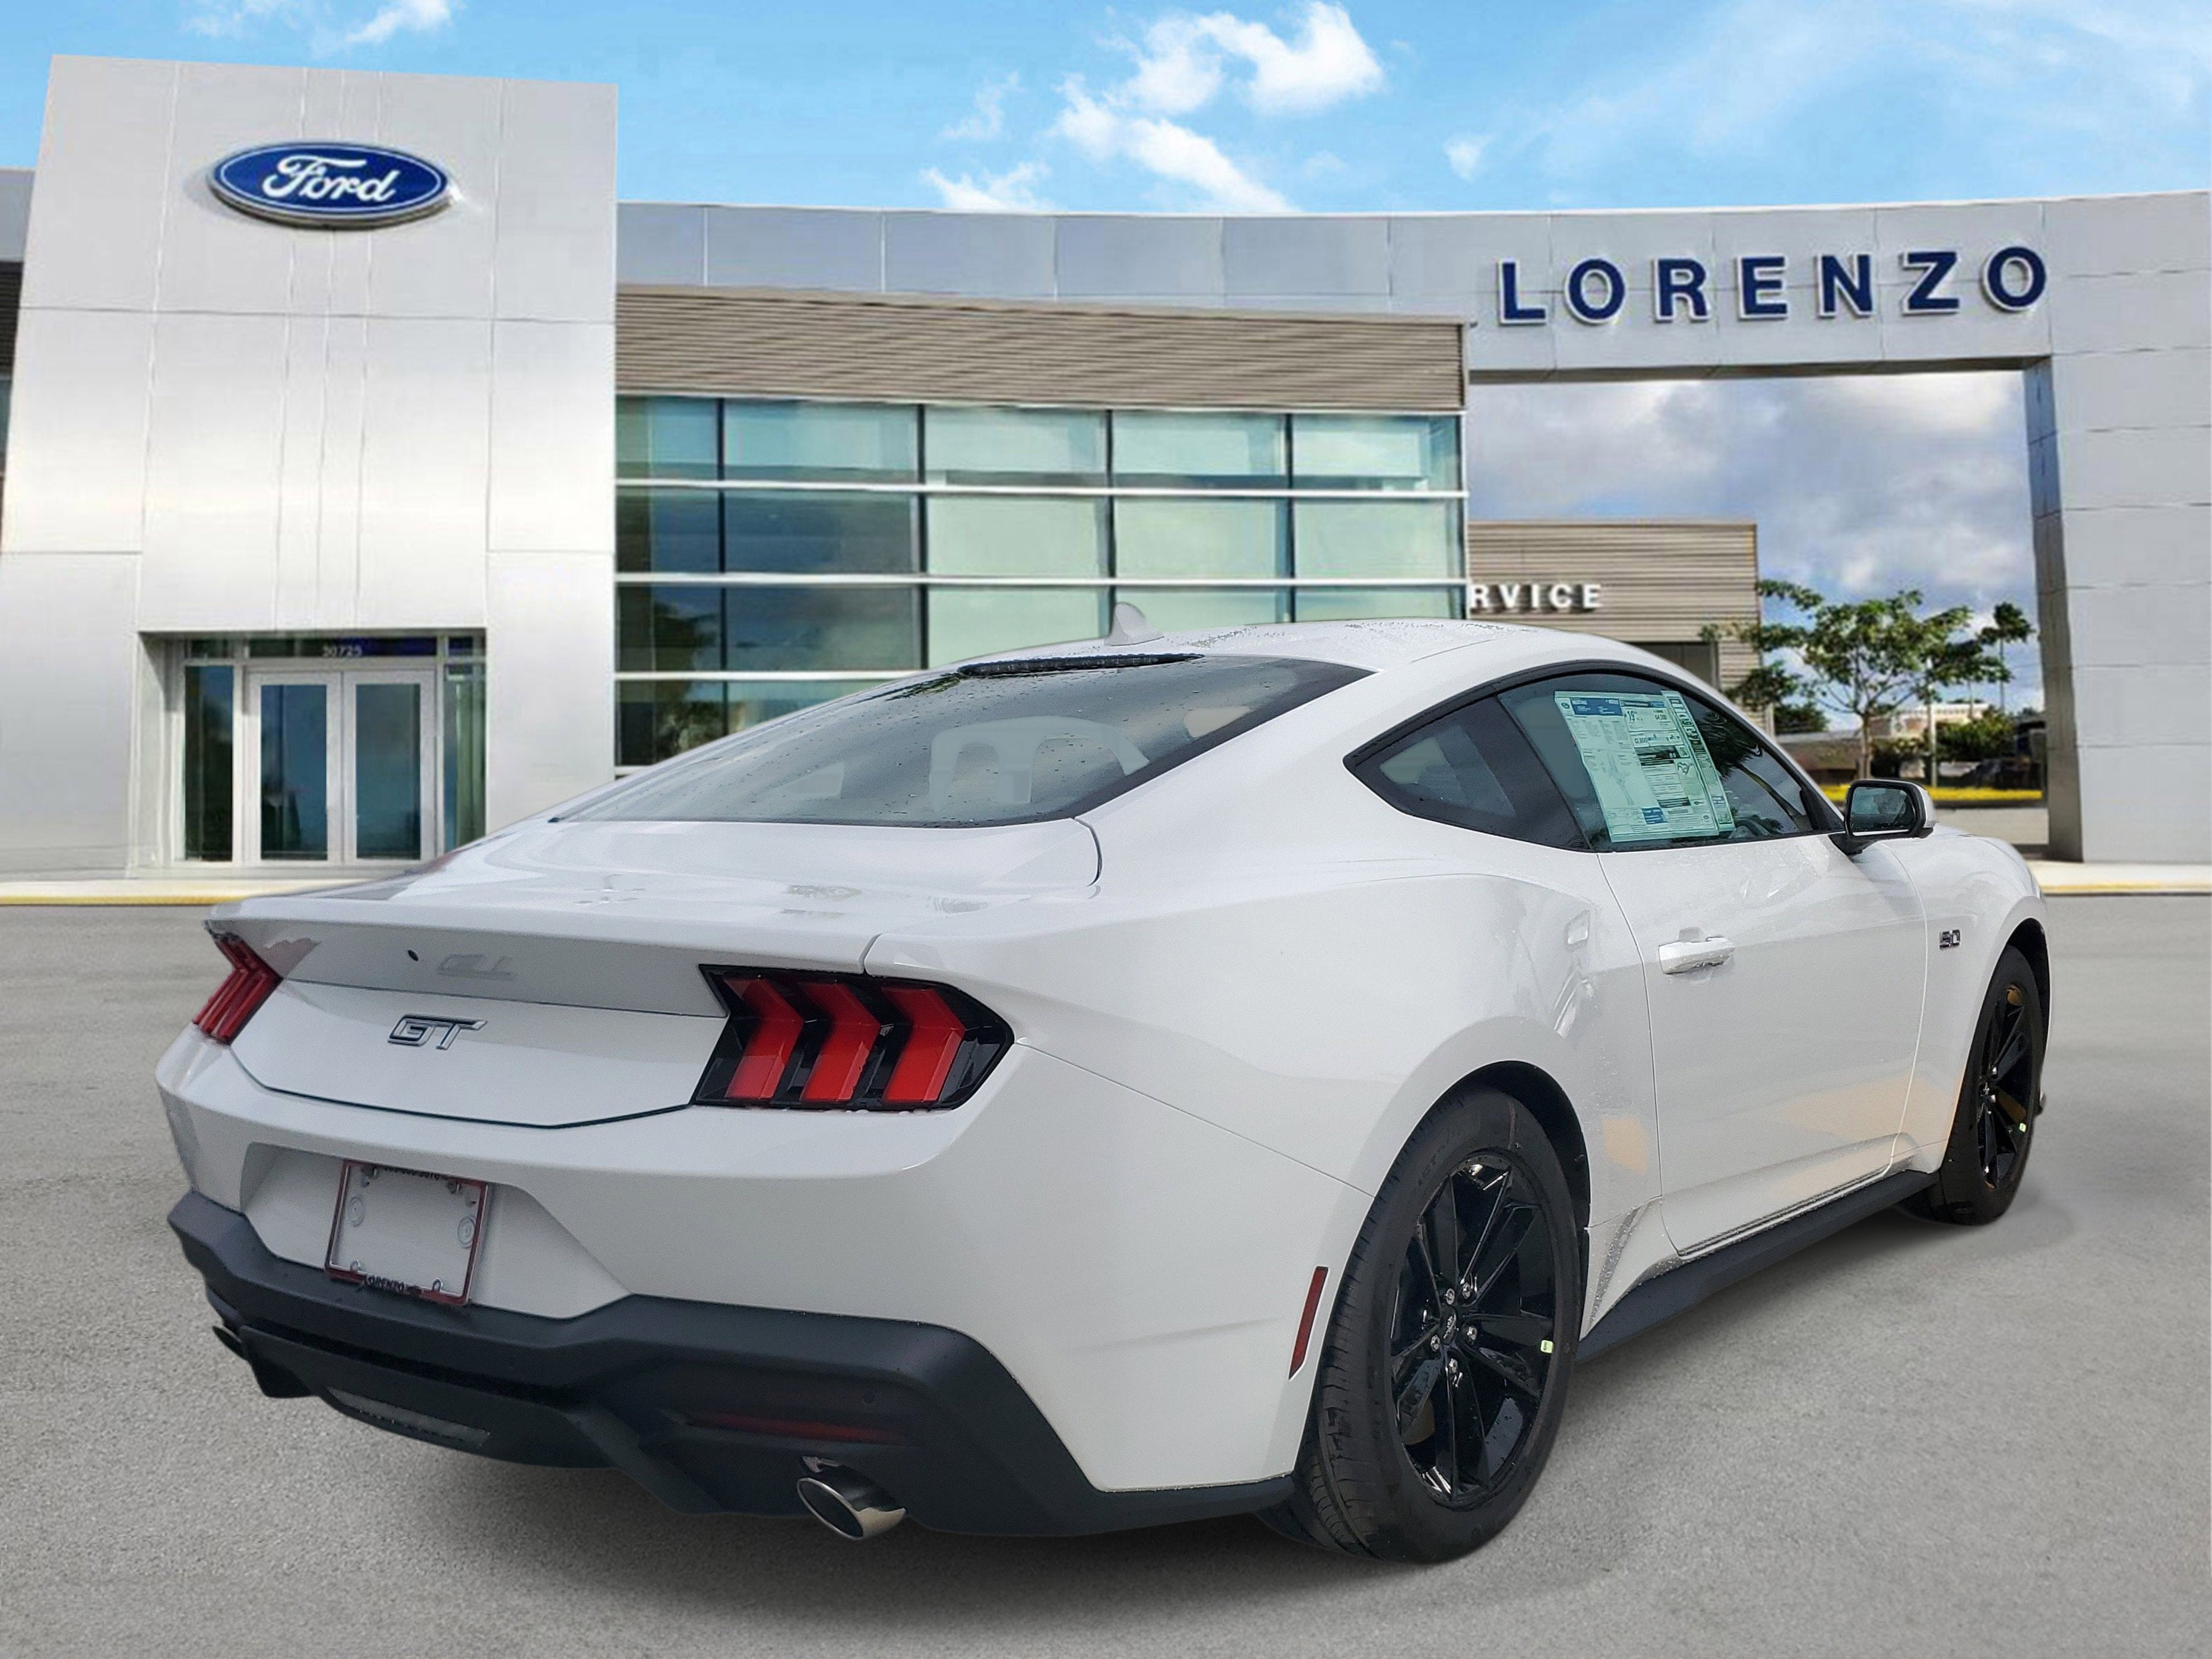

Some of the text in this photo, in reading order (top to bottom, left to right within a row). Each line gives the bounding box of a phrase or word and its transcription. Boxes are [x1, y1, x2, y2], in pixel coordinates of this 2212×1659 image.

[262, 154, 400, 202] Ford
[1498, 245, 2048, 325] LORENZO
[387, 1012, 488, 1050] GT
